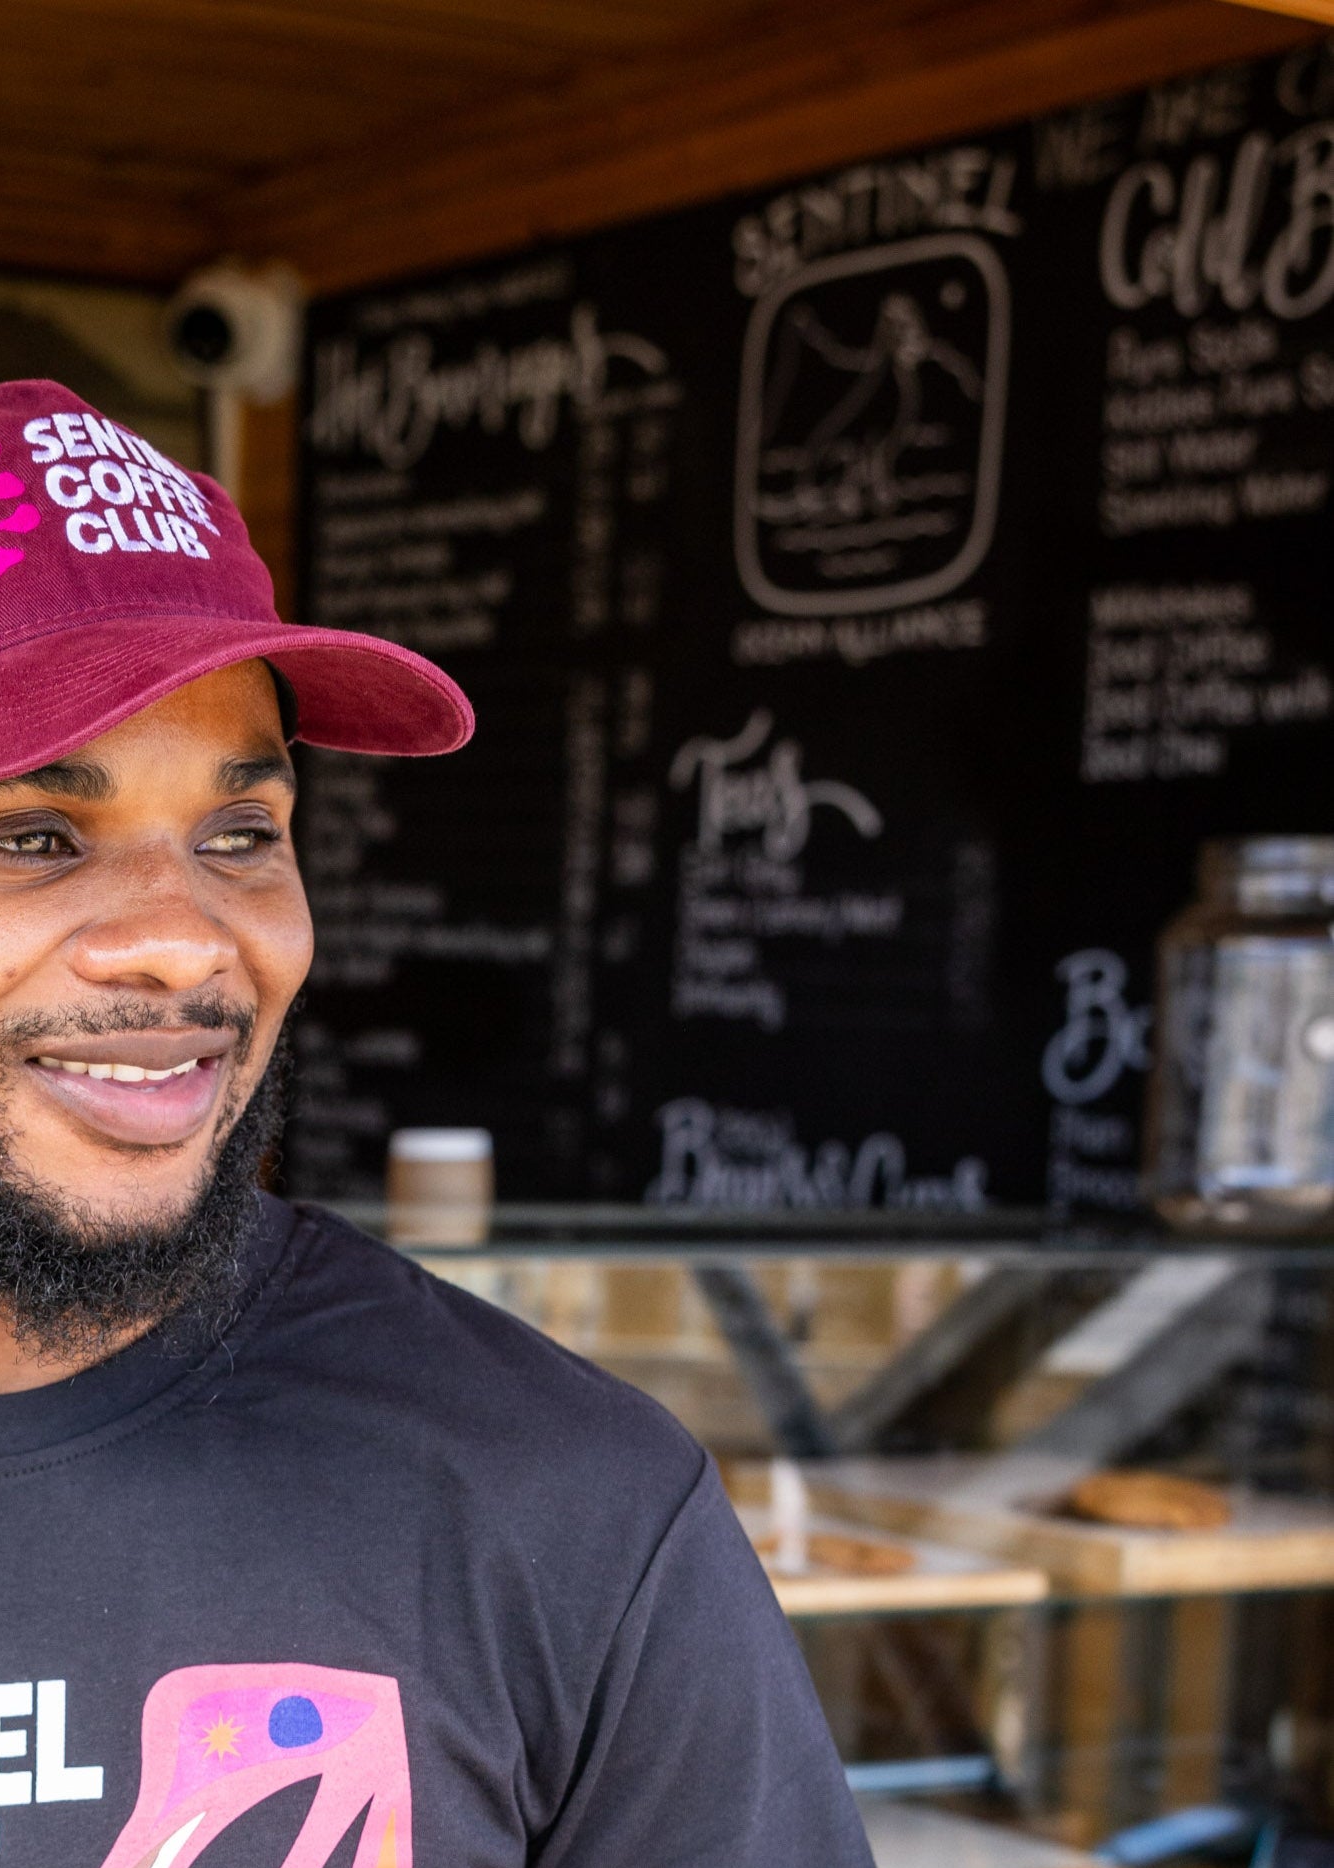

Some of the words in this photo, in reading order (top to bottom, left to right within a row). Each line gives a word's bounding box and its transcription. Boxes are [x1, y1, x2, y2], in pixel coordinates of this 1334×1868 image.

[731, 145, 1023, 298] SENTINEL
[45, 459, 220, 537] COFFEE
[65, 506, 210, 559] CLUB
